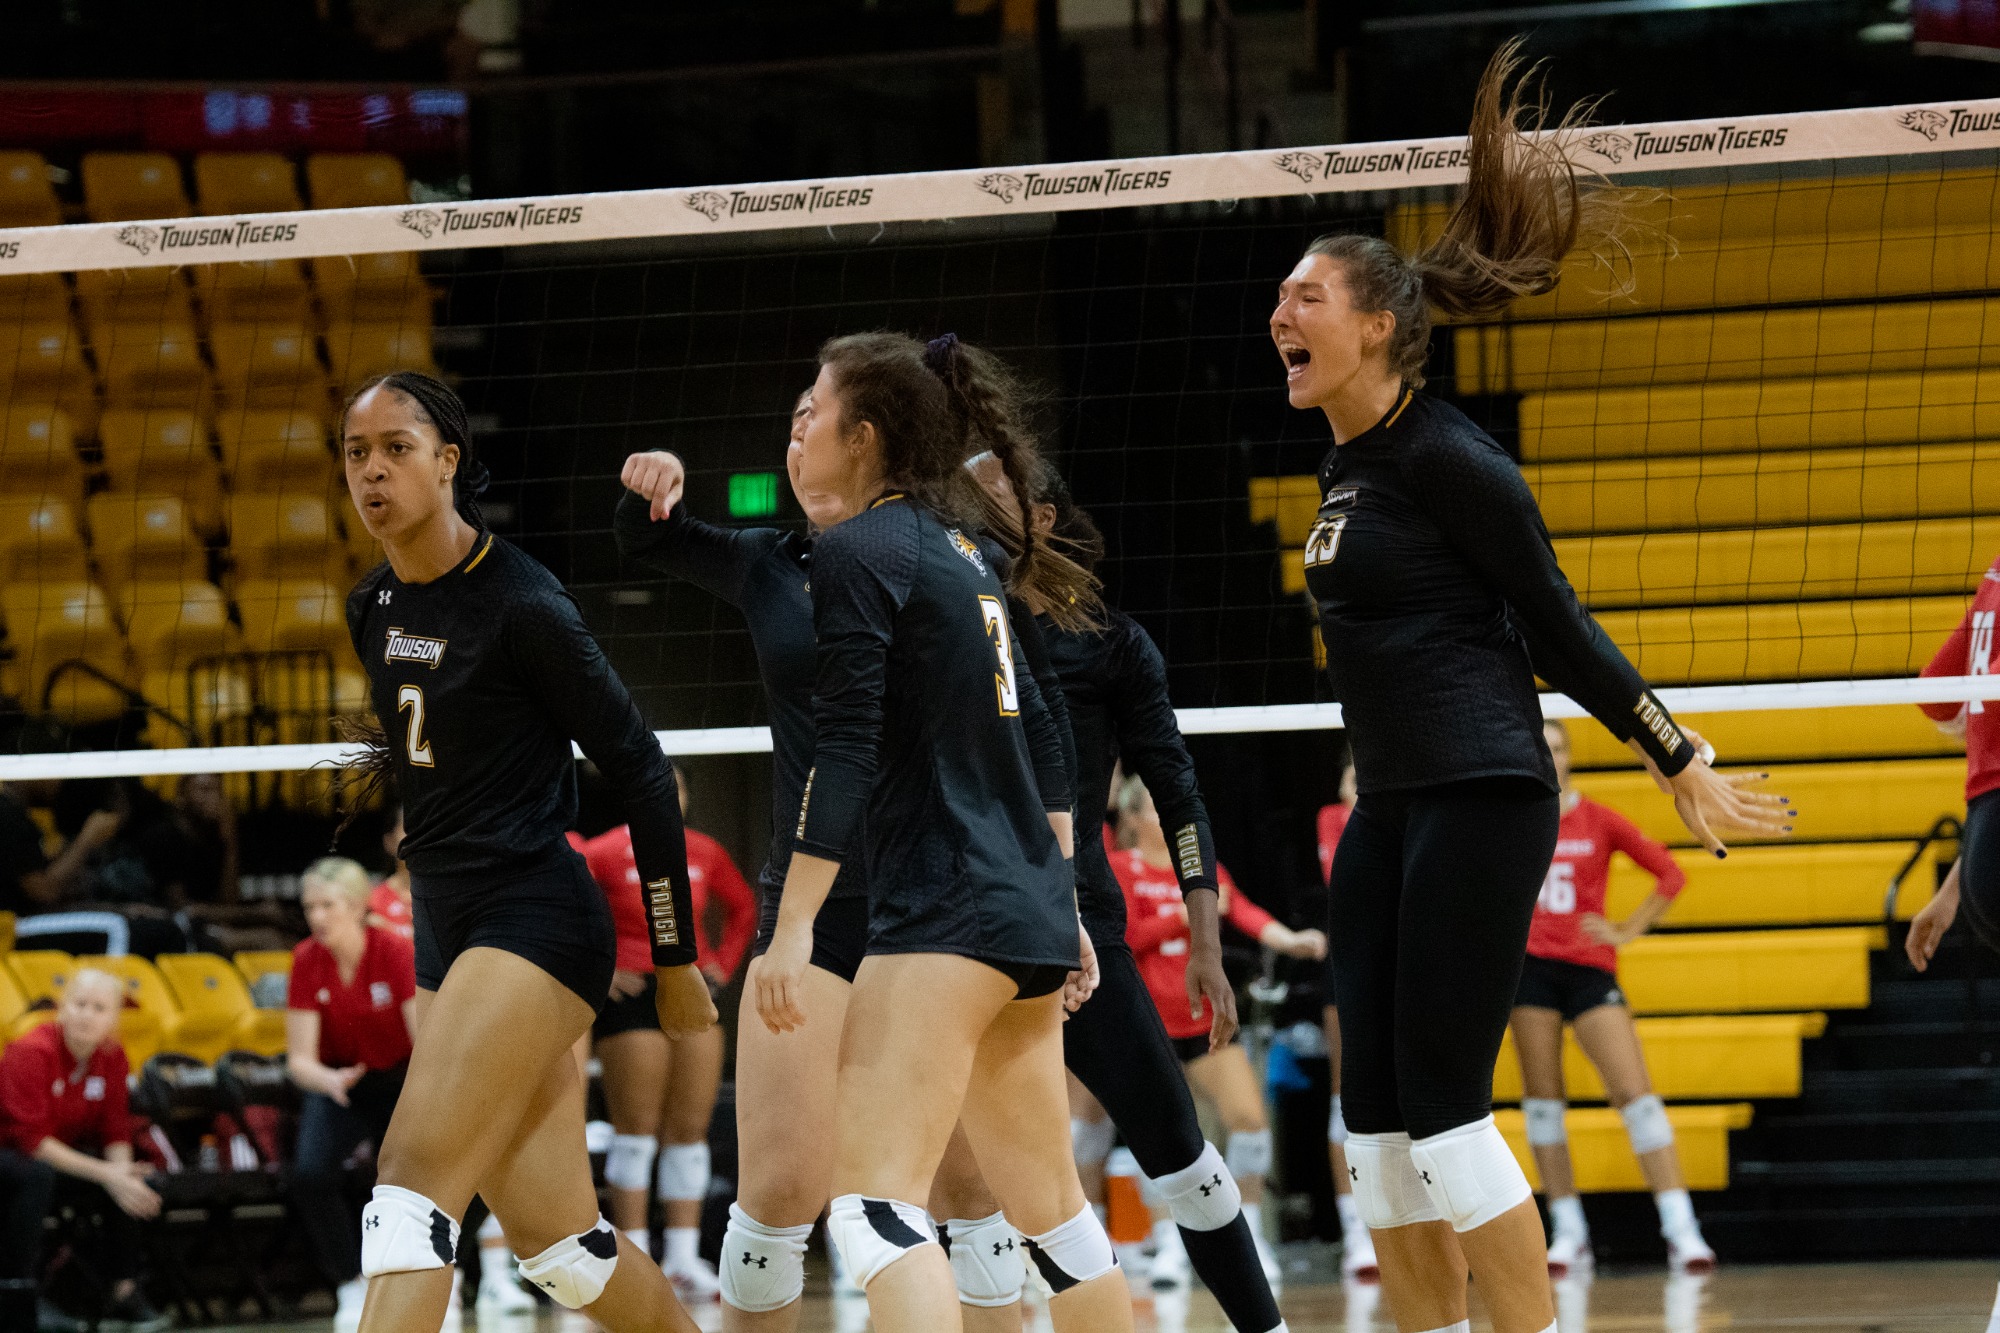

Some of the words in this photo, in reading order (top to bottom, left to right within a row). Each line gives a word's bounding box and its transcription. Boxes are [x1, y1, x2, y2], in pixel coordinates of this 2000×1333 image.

[1304, 513, 1348, 570] 23
[385, 627, 448, 669] TOWSON
[978, 594, 1019, 717] 3
[398, 684, 435, 768] 2
[1633, 691, 1683, 757] TOUGH
[1175, 823, 1204, 880] TOUGH
[647, 877, 679, 946] TOUGH
